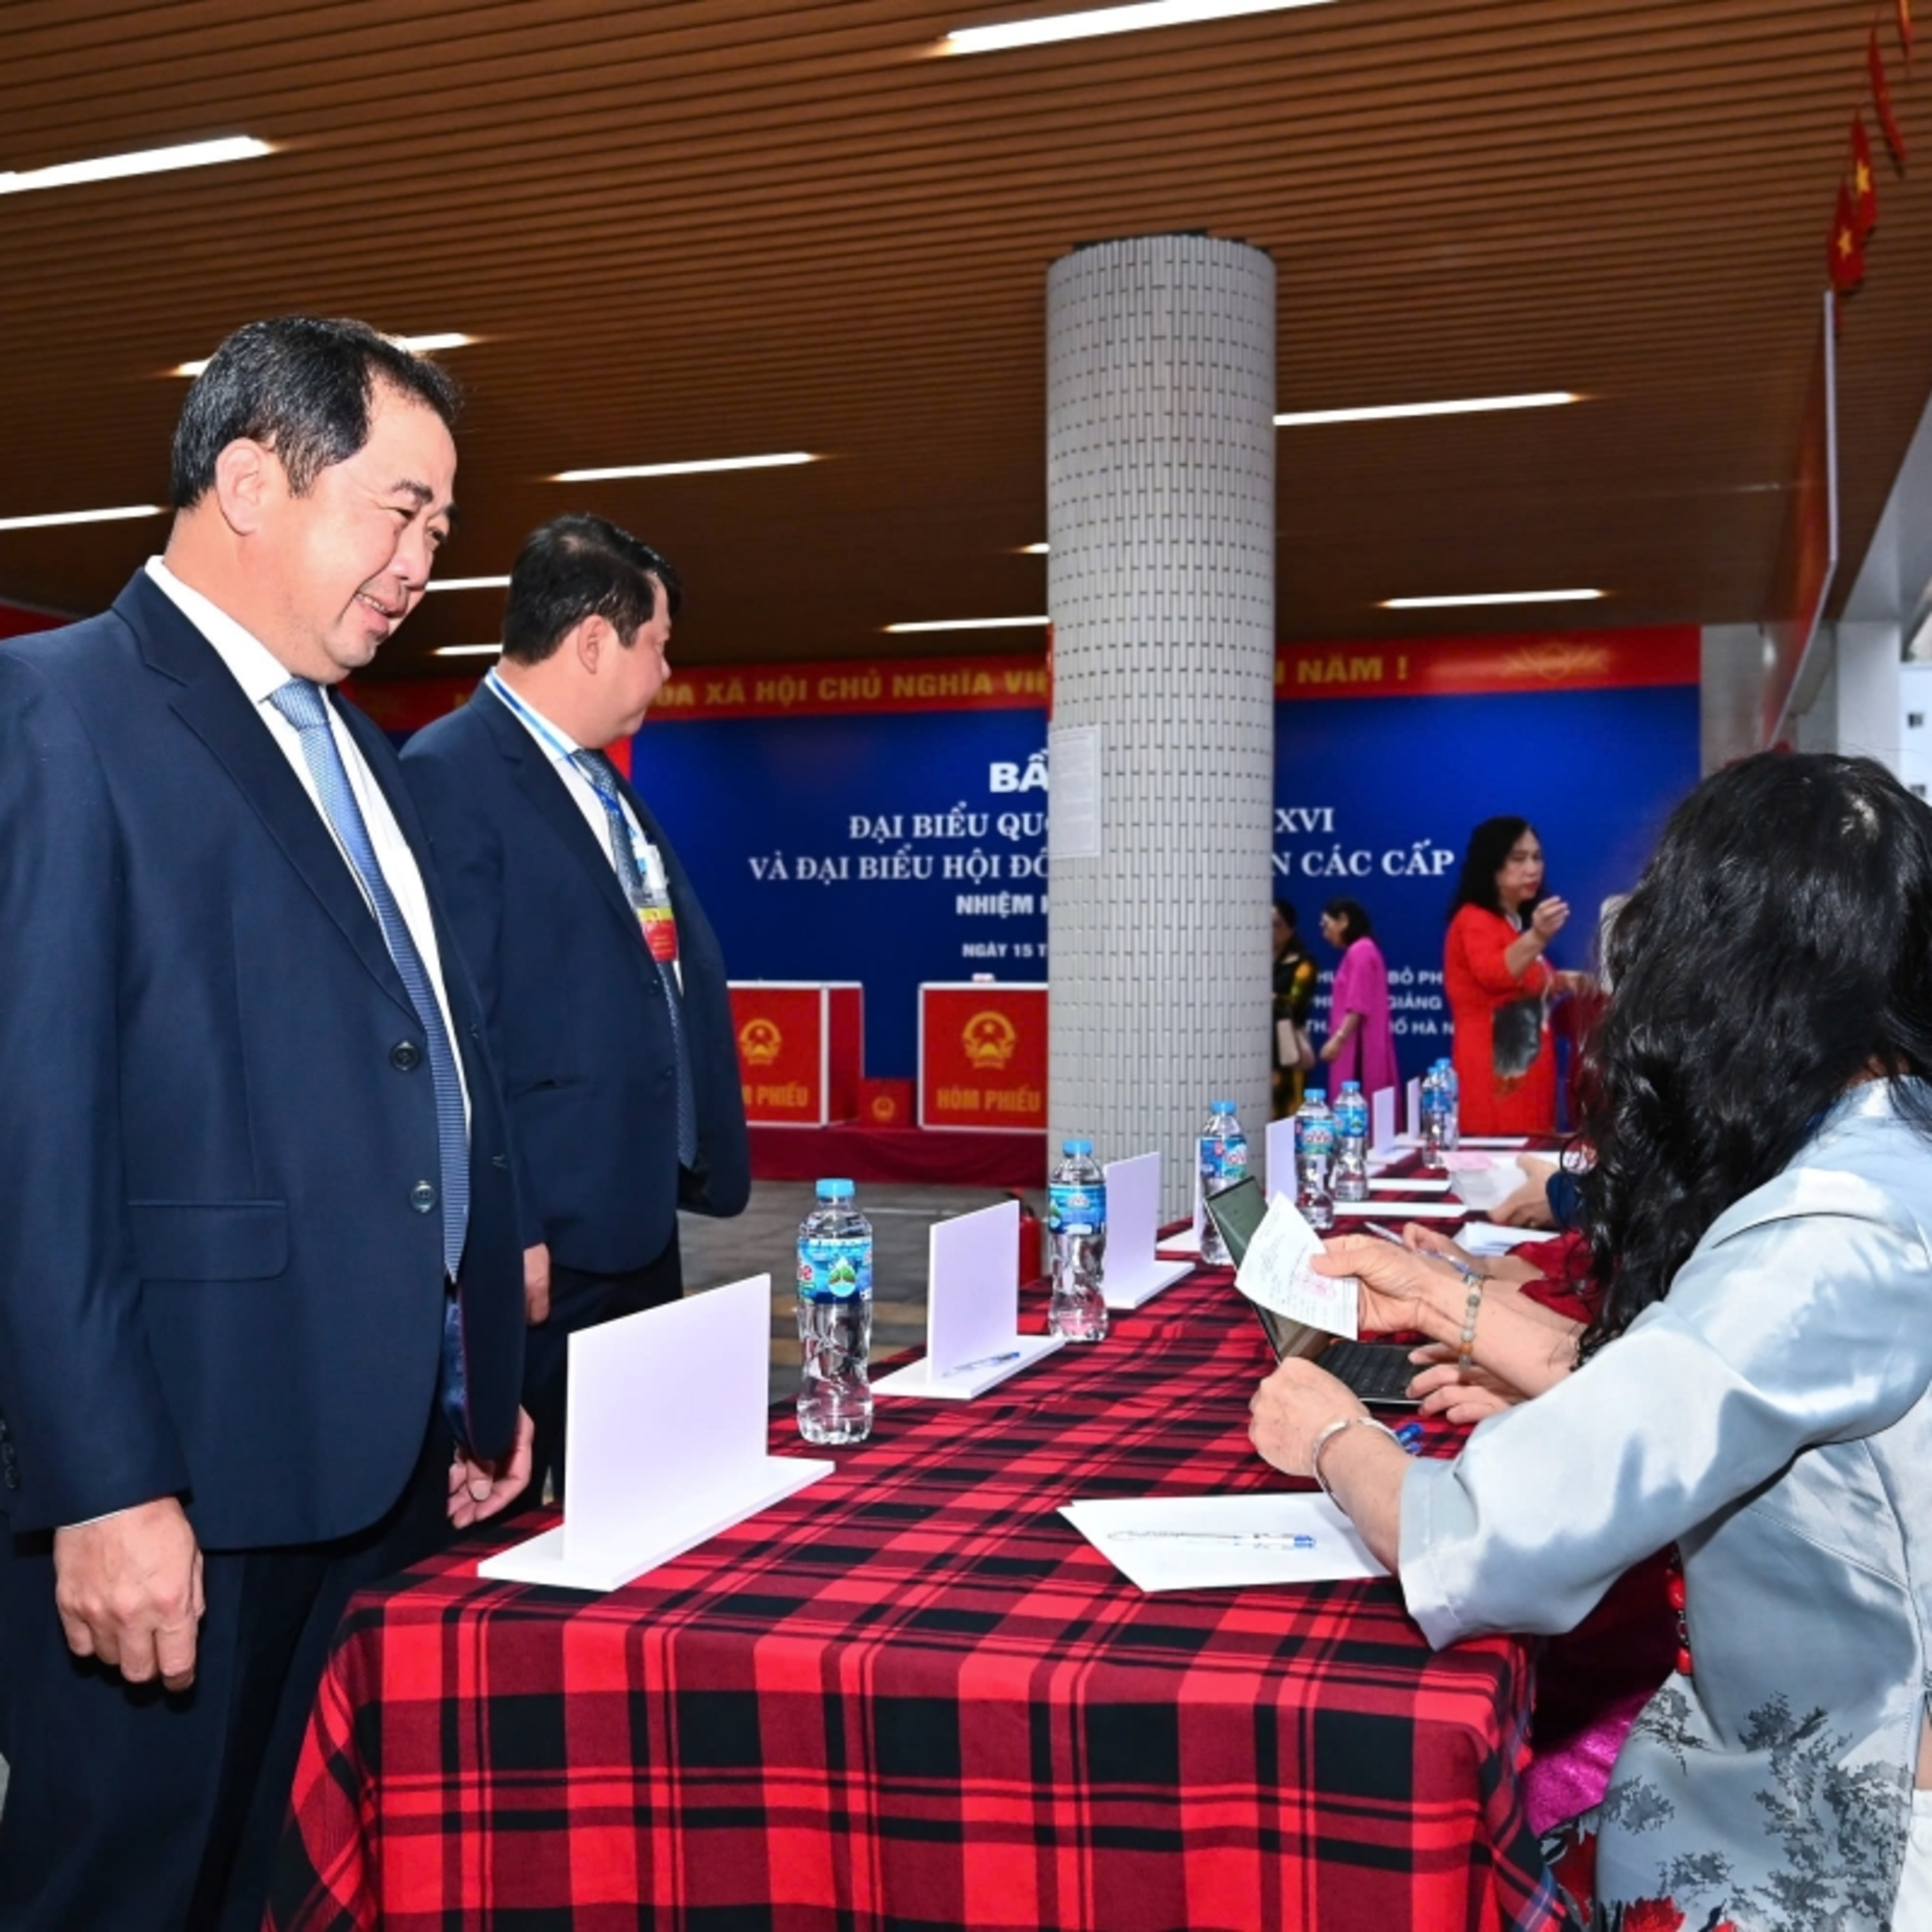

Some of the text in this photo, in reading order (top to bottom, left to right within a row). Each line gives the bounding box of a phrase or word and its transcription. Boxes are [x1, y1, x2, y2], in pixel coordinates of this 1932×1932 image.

[755, 674, 808, 707] HỘI
[819, 668, 882, 700] CHỦ
[893, 667, 993, 697] NGHĨA
[1005, 668, 1047, 696] VIỆ
[1297, 654, 1383, 683] NĂM
[989, 749, 1048, 793] BẦ
[849, 801, 1334, 844] ĐẠI BIỂU QU XVI
[749, 851, 789, 880] VÀ
[797, 857, 849, 885] ĐẠI
[858, 844, 933, 879] BIỂU
[943, 848, 1000, 884] HỘI
[1301, 843, 1372, 876] CÁC
[1381, 838, 1455, 876] CẤP
[956, 891, 1034, 918] NHIỆM
[962, 939, 1007, 958] NGÀY
[1014, 943, 1033, 958] 15
[985, 1083, 1041, 1113] PHIẾU
